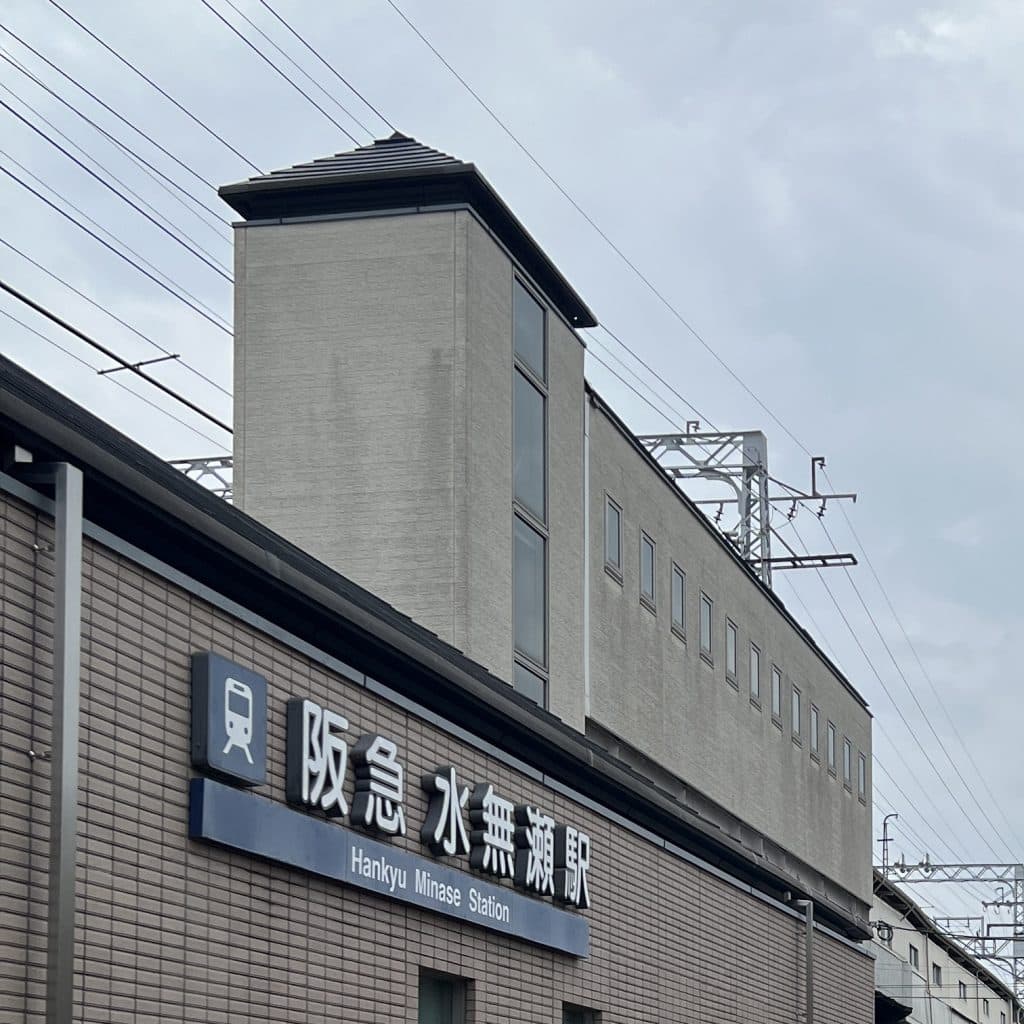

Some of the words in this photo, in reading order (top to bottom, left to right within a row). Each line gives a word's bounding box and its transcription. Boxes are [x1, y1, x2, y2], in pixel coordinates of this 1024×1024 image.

[351, 846, 407, 893] Hankyu
[415, 868, 461, 907] Minase
[469, 888, 510, 923] Station
